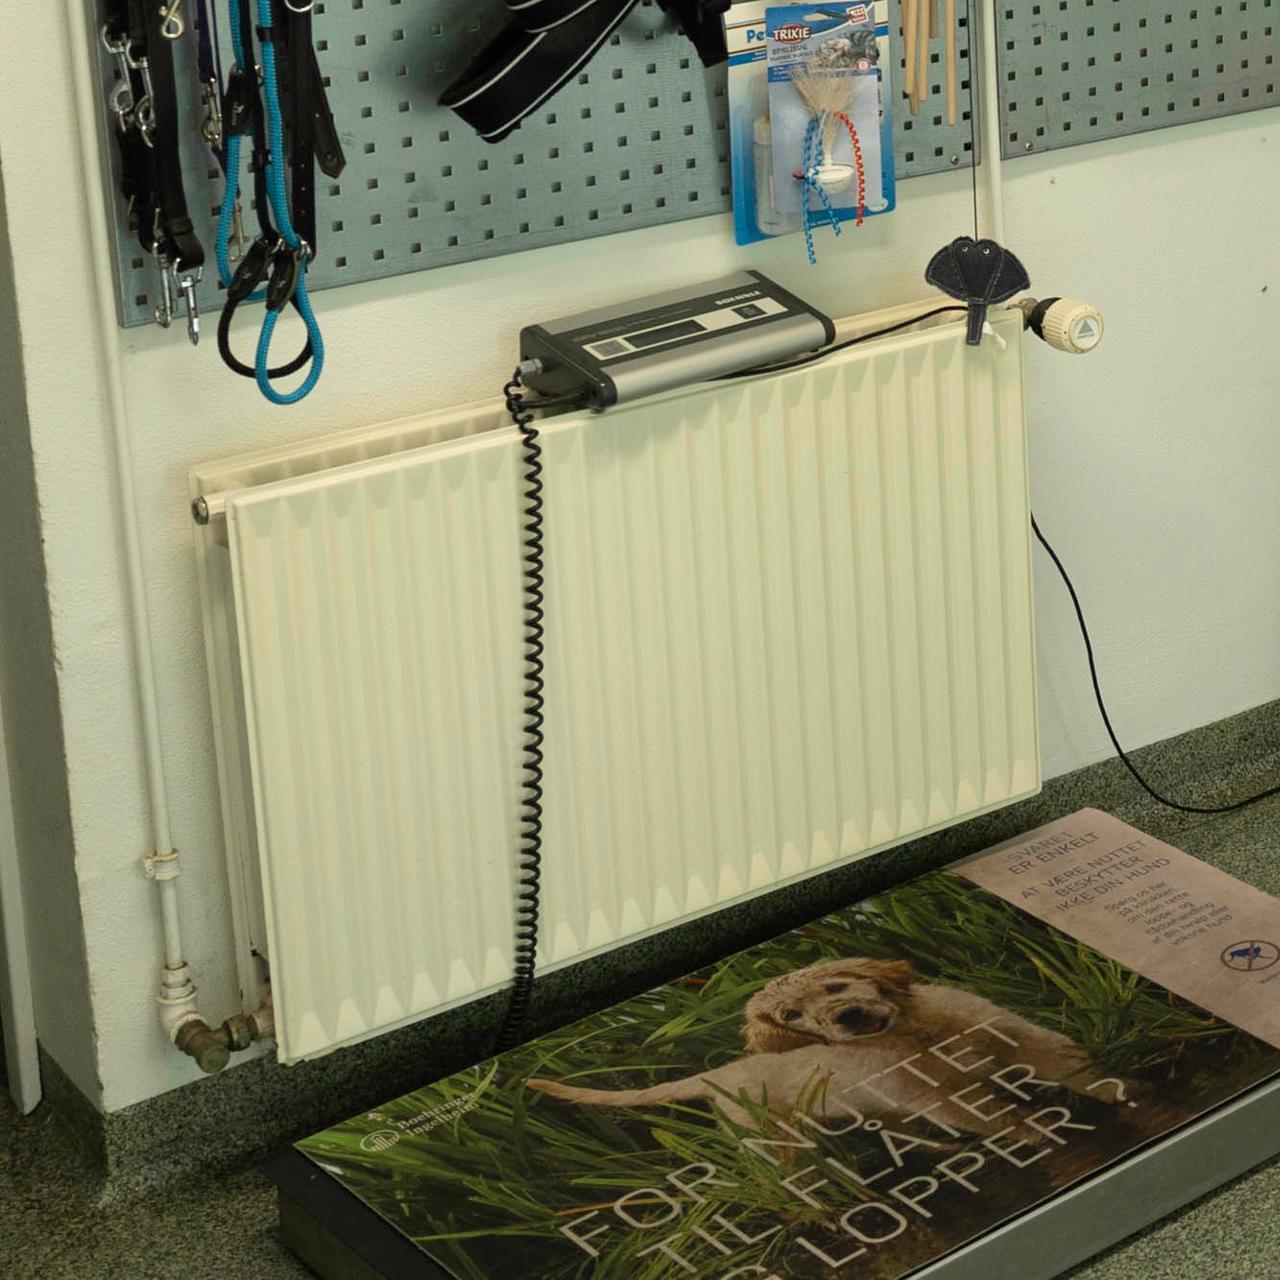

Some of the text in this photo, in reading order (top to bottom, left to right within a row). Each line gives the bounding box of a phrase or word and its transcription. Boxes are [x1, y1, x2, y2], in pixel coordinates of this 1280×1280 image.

[773, 27, 811, 41] TRIXIE
[1008, 831, 1074, 861] SVARET
[1008, 832, 1100, 875] ER ENKELT
[1021, 839, 1147, 899] AT VÆRE NUTTET
[1054, 855, 1143, 897] BESKYTTER
[1056, 857, 1171, 912] IKKE DIN HUND
[559, 1016, 1019, 1258] FOR NUTTET
[636, 1062, 1060, 1275] TIL FLÅTER
[795, 1077, 1138, 1269] LOPPER ?
